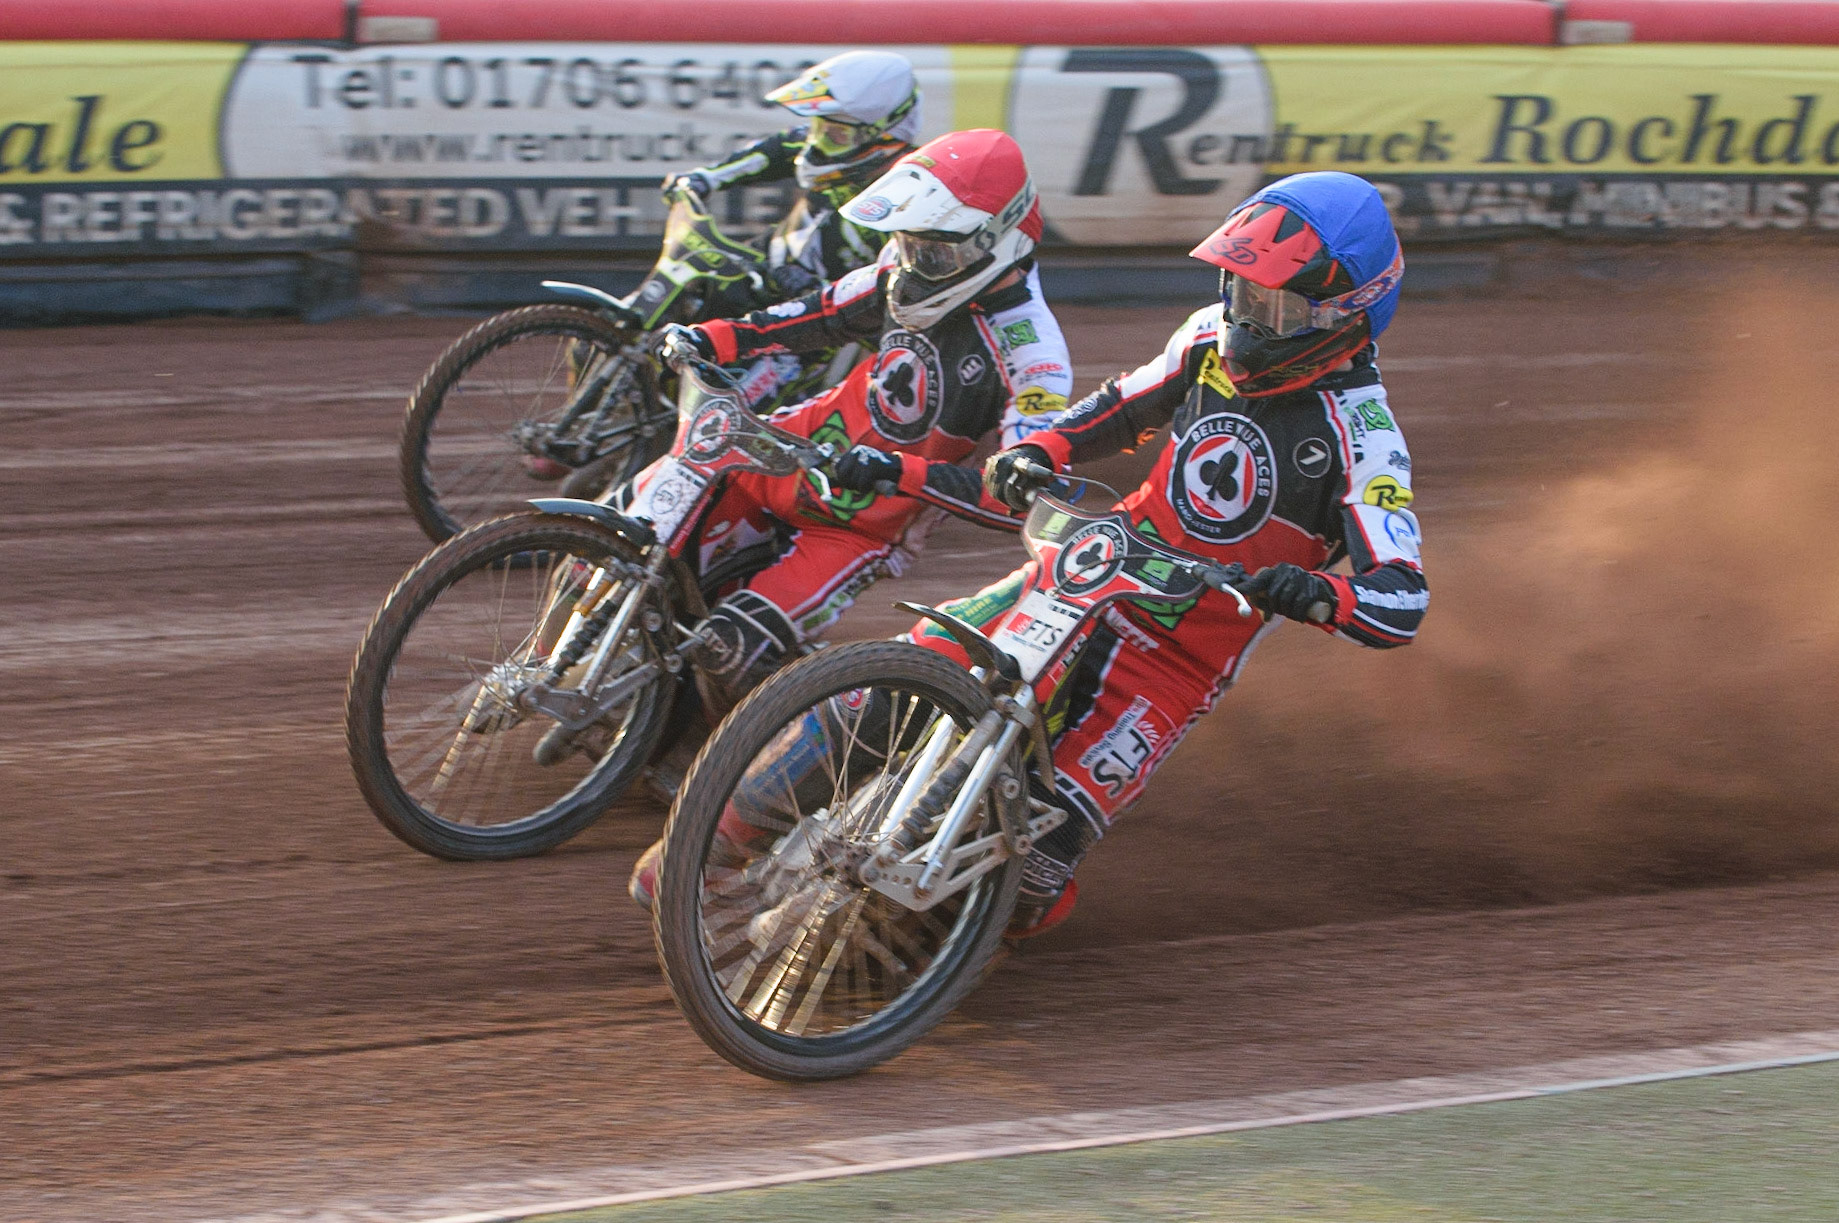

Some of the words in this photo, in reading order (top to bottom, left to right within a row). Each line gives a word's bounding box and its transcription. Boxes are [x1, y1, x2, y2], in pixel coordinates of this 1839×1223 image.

[293, 56, 416, 108] Tel:
[435, 56, 647, 108] 01706
[41, 189, 507, 241] REFRIGERATED
[1191, 420, 1234, 443] BELLE
[1236, 423, 1262, 450] VUE
[1256, 456, 1271, 498] ACES
[1093, 727, 1152, 797] FTS
